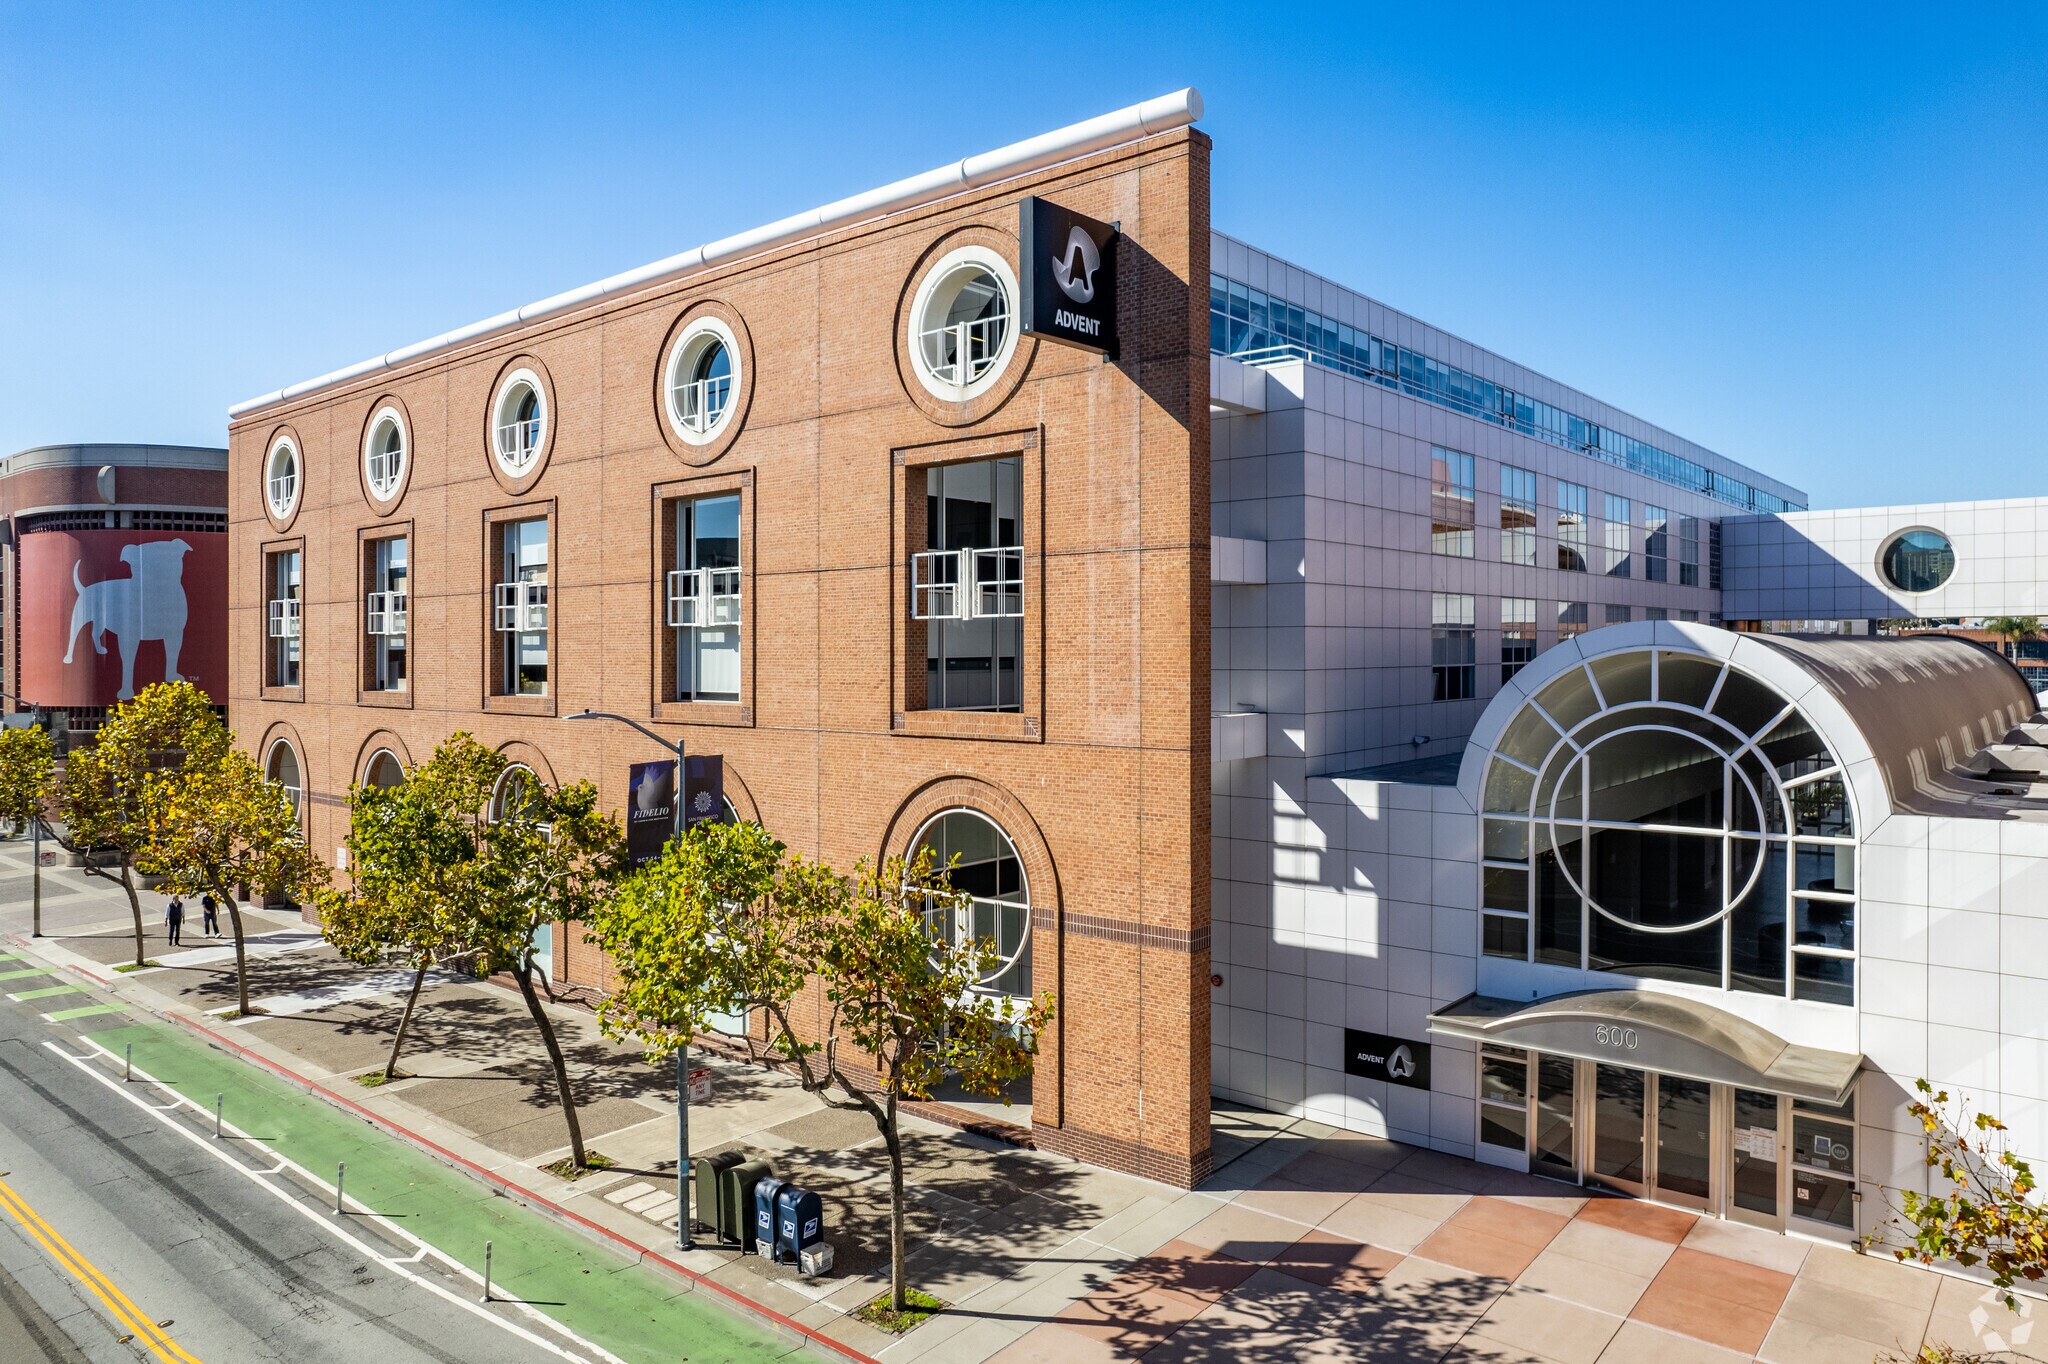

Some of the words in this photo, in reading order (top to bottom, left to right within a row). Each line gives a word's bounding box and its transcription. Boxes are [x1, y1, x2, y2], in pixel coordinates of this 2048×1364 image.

[1055, 308, 1100, 336] ADVENT
[633, 806, 669, 819] FIDELIO
[1595, 1023, 1638, 1050] 600
[1357, 1052, 1385, 1064] ADVENT
